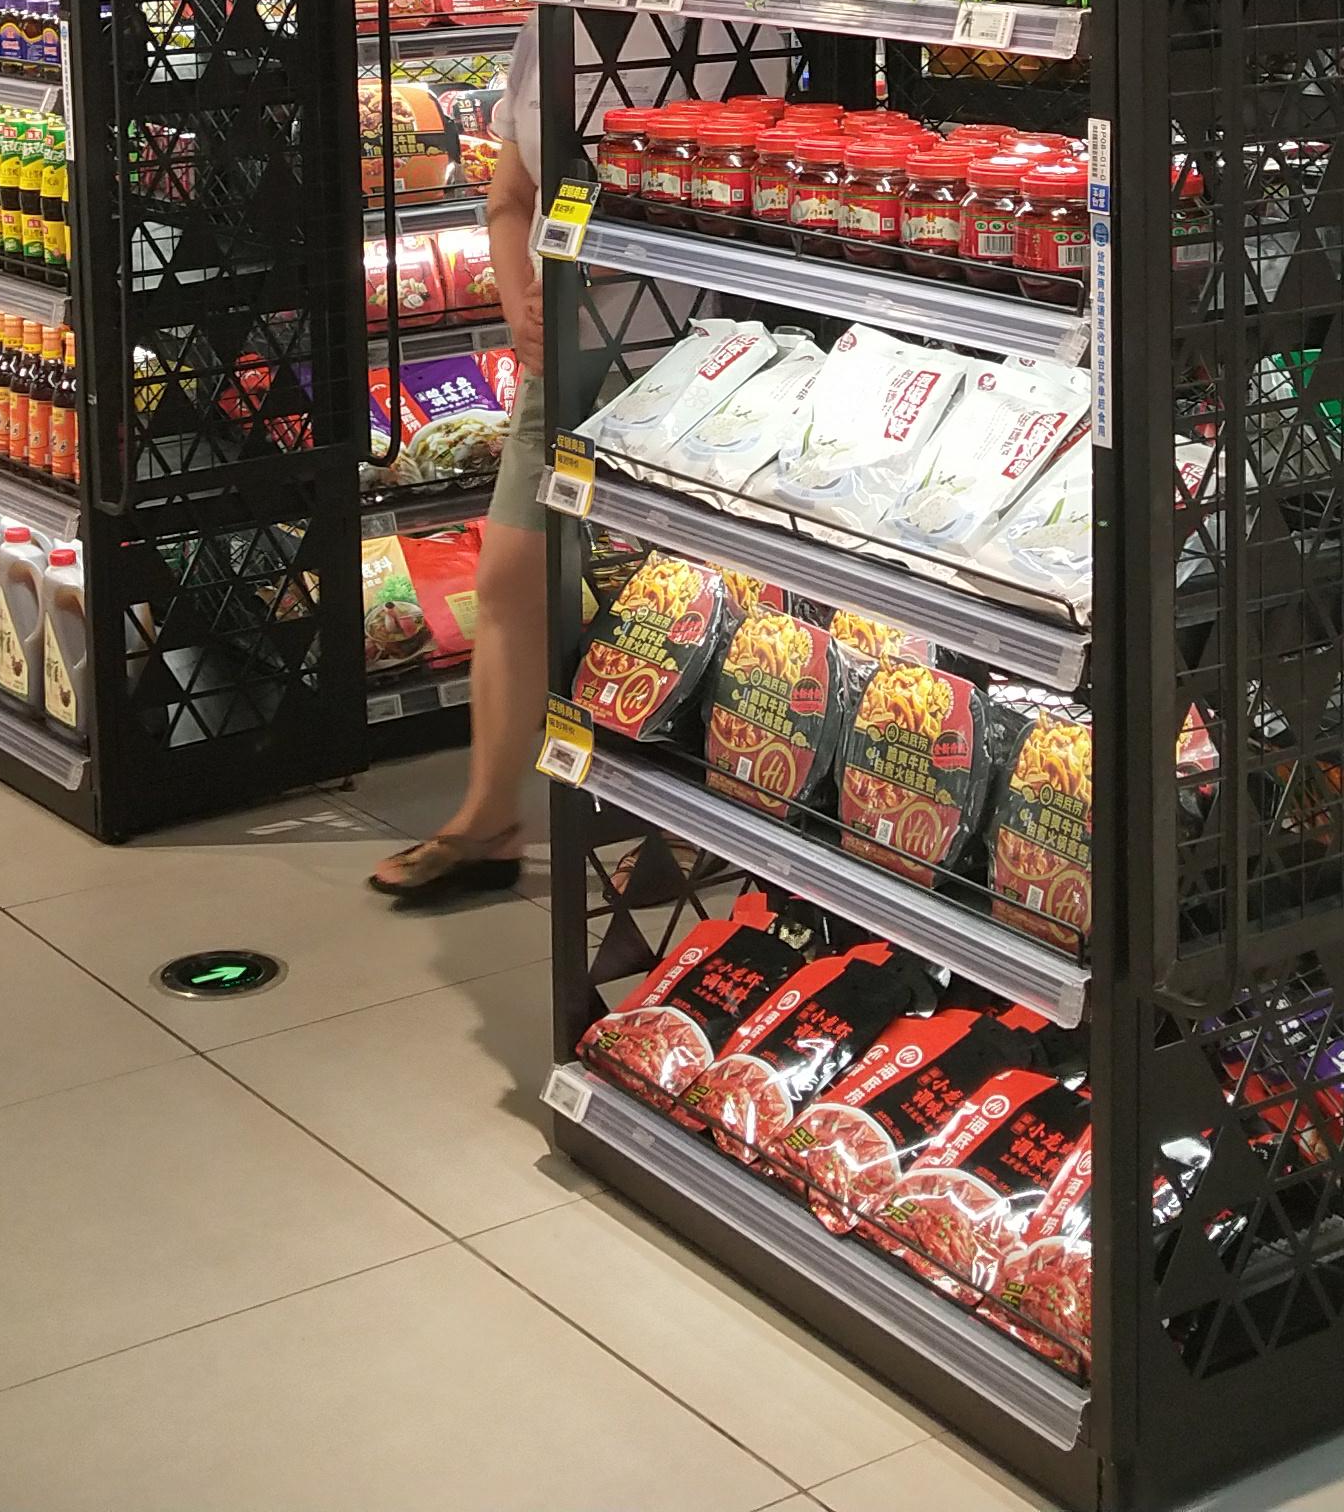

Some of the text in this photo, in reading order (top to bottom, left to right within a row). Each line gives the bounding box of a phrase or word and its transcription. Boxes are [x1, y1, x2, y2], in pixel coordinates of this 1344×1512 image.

[844, 1062, 900, 1106] 海底捞
[931, 1078, 966, 1106] 小龙
[940, 1114, 989, 1167] 海底捞
